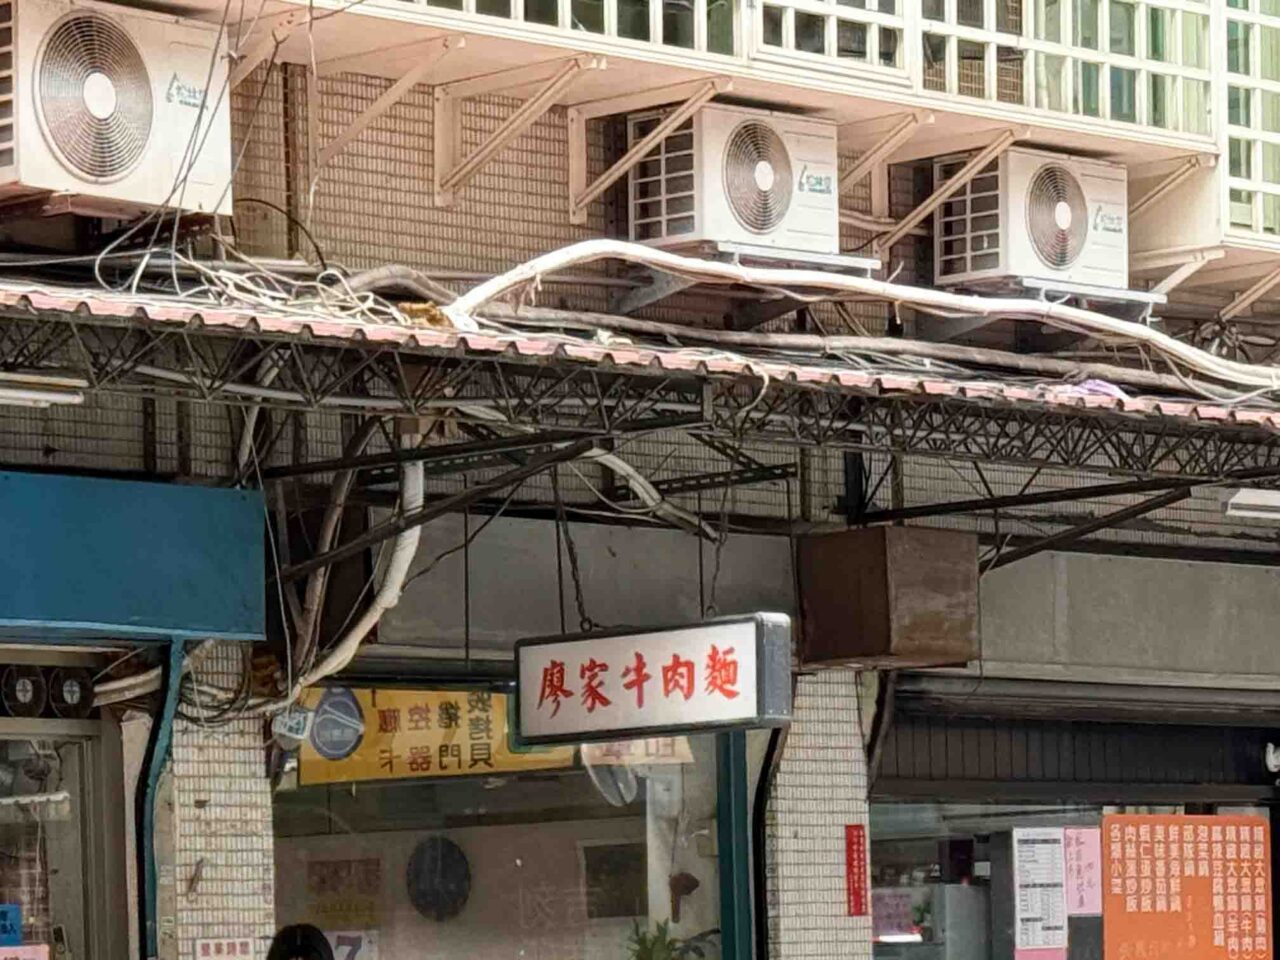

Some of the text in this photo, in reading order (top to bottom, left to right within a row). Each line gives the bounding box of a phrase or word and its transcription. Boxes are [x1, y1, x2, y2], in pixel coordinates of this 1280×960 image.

[537, 644, 740, 719] 廖家牛肉麵
